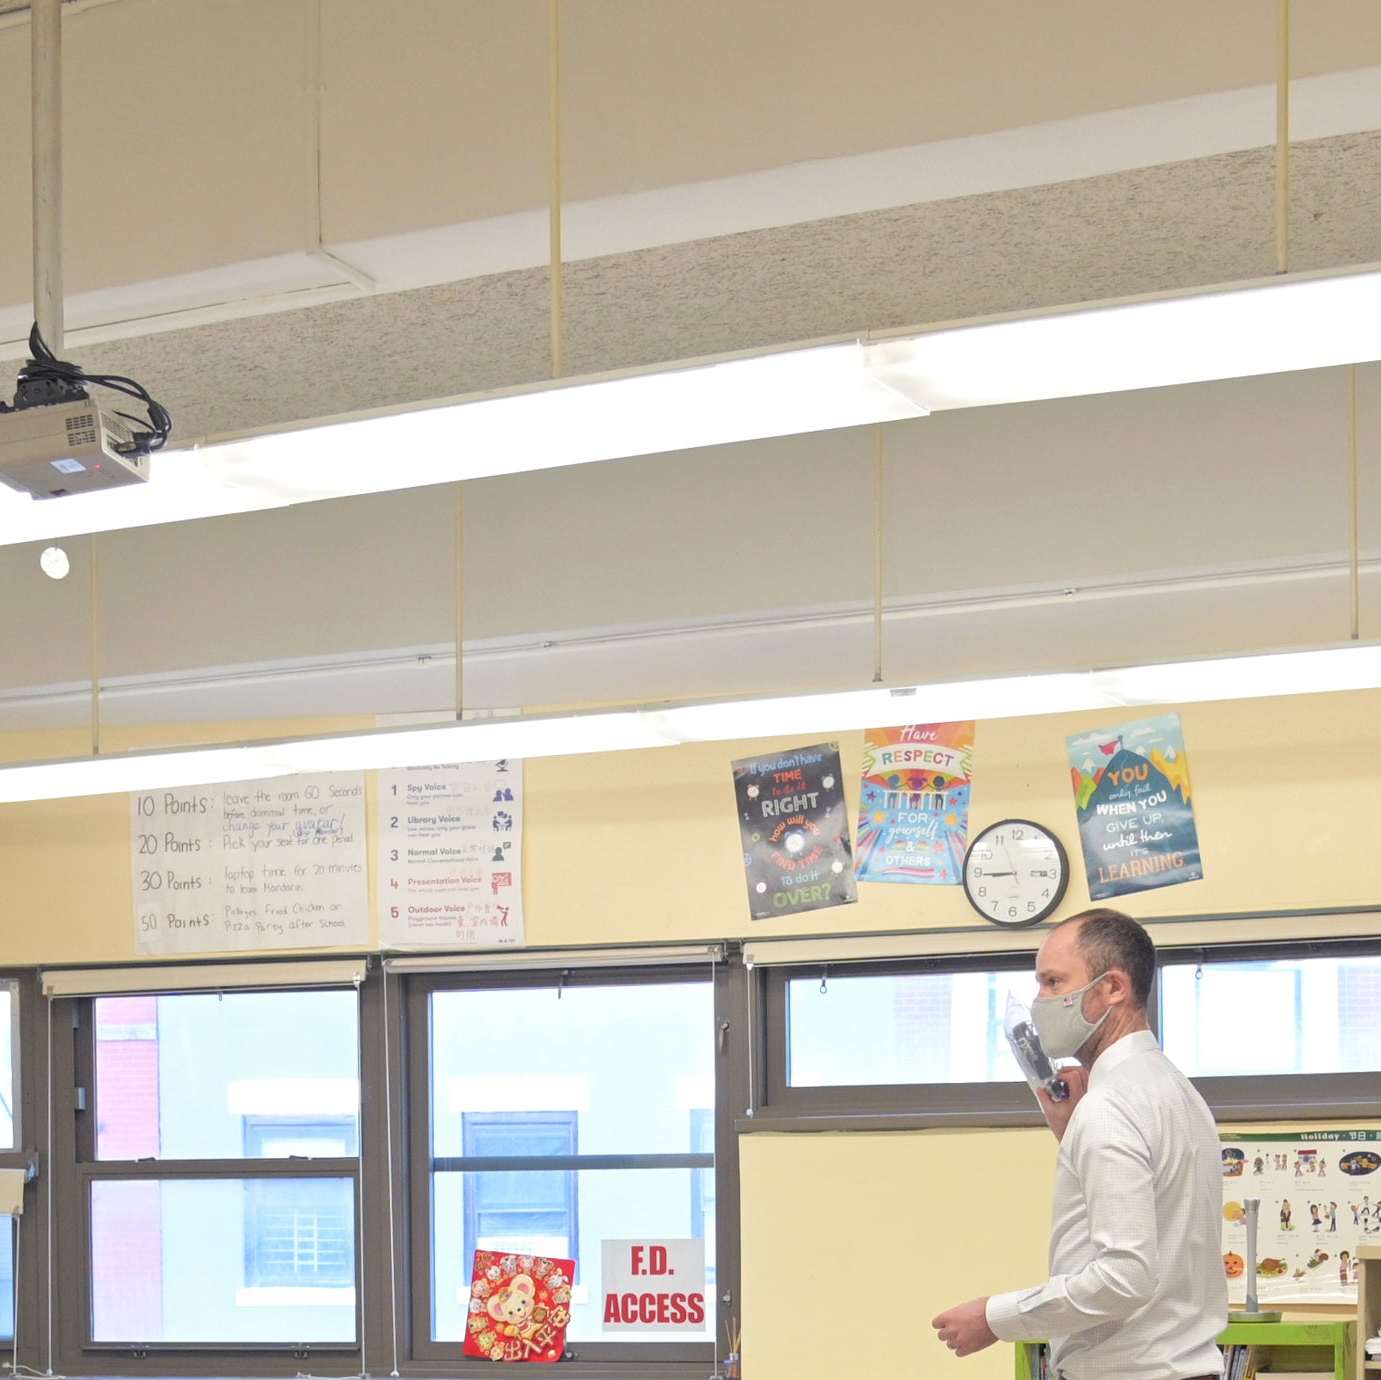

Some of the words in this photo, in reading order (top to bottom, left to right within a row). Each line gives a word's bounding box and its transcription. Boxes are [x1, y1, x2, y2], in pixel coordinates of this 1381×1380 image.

[900, 724, 939, 742] Have
[758, 762, 776, 776] you
[801, 753, 822, 764] have
[882, 750, 955, 767] RESPECT
[773, 769, 803, 783] TIME
[1107, 763, 1149, 786] YOU
[391, 784, 397, 796] 1
[407, 784, 422, 792] Spy
[1108, 788, 1132, 801] only
[1134, 783, 1152, 797] fail
[137, 795, 154, 817] 10
[223, 791, 250, 806] leave
[256, 788, 271, 802] the
[278, 792, 299, 802] room
[761, 792, 819, 818] RIGHT
[1096, 800, 1137, 816] WHEN
[1137, 789, 1168, 811] YOU
[390, 816, 399, 828] 2
[407, 817, 436, 825] Library
[438, 815, 461, 823] Voice
[898, 812, 928, 823] FOR
[1106, 818, 1139, 833] GIVE
[770, 821, 786, 843] how
[786, 814, 804, 826] will
[804, 819, 820, 837] you
[885, 819, 939, 844] yourself
[1012, 830, 1024, 841] 12
[138, 834, 158, 854] 20
[222, 836, 245, 850] Pick
[252, 839, 272, 853] your
[1102, 832, 1138, 851] until
[1140, 829, 1173, 842] then
[390, 849, 398, 861] 3
[408, 848, 438, 856] Normal
[770, 851, 795, 871] FIND
[798, 845, 824, 869] TIME
[885, 855, 931, 866] OTHERS
[140, 870, 163, 891] 30
[224, 865, 254, 880] laptop
[261, 865, 286, 878] time
[328, 863, 363, 873] minutes
[390, 878, 399, 889] 4
[408, 877, 460, 886] Presentation
[795, 873, 810, 883] do
[811, 871, 819, 880] it
[772, 882, 833, 909] OVER?
[391, 906, 399, 919] 5
[408, 906, 443, 914] Outdoor
[444, 905, 465, 913] Voice
[141, 915, 157, 932] 50
[224, 920, 250, 932] Pizza
[289, 920, 312, 929] after
[1301, 1132, 1340, 1142] Holiday
[630, 1245, 675, 1276] F.D.
[603, 1292, 705, 1324] ACCESS
